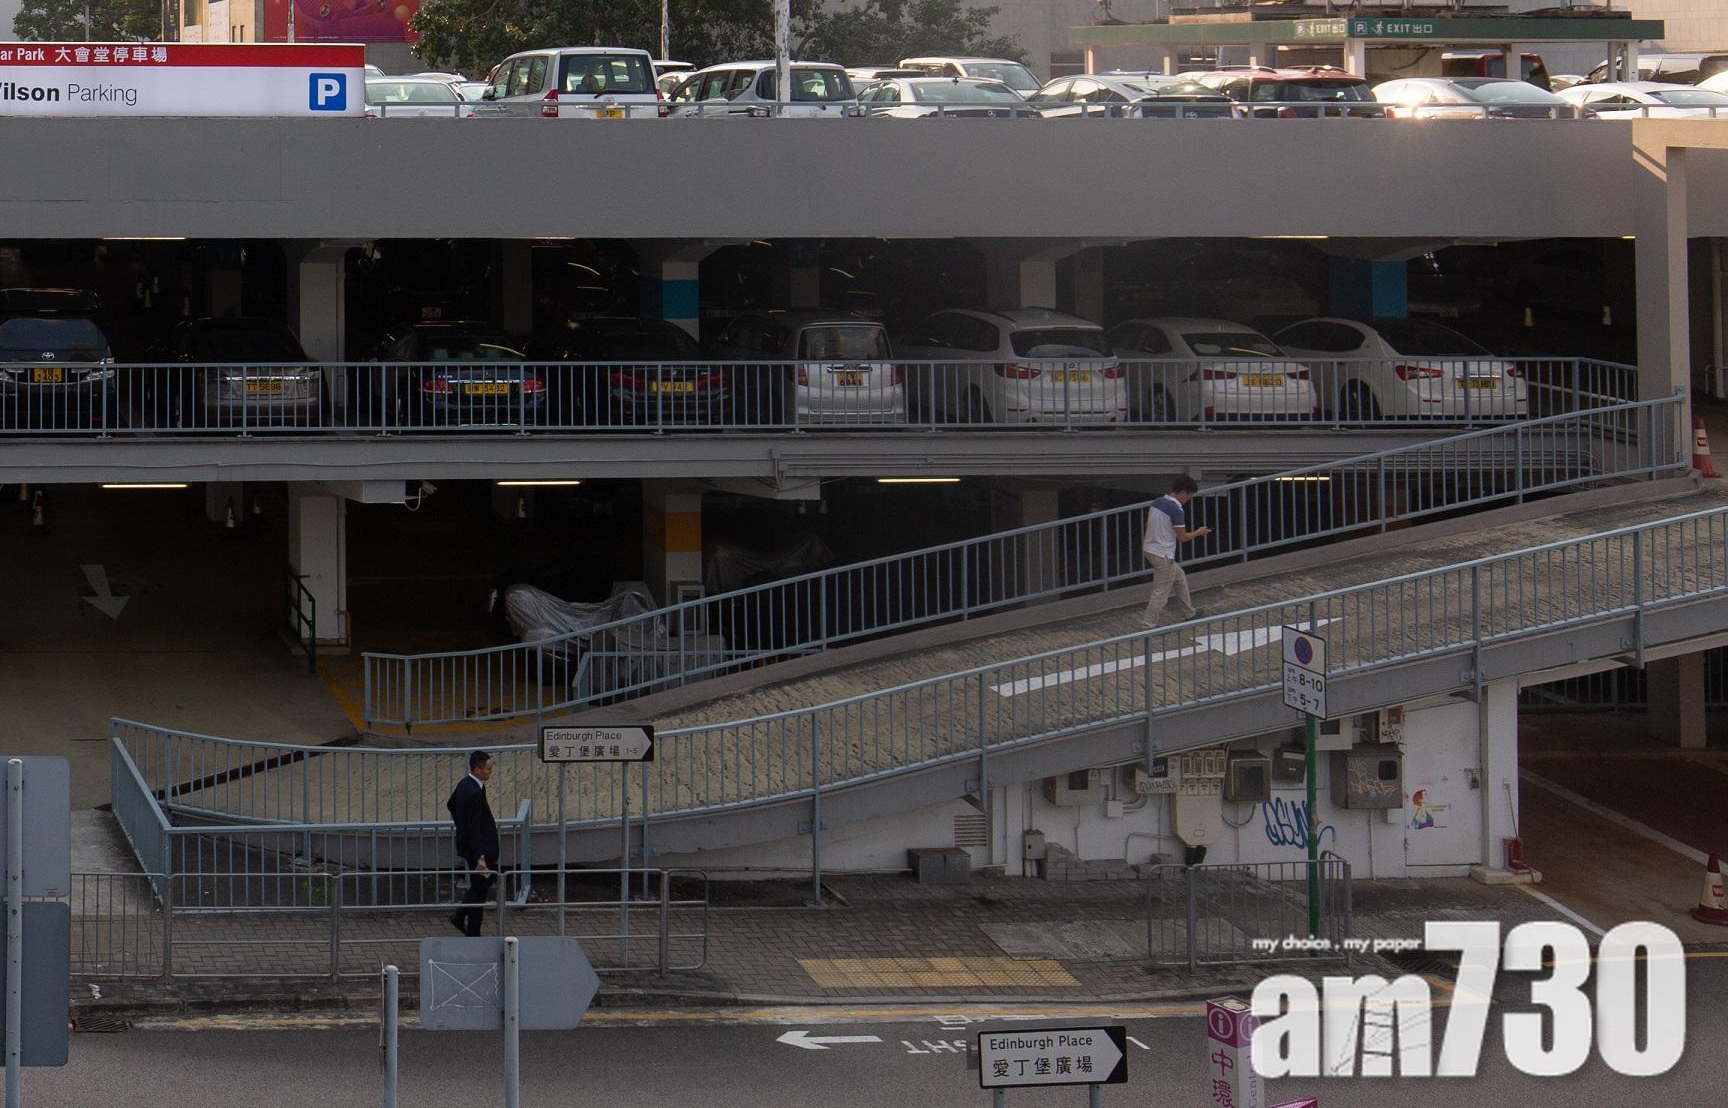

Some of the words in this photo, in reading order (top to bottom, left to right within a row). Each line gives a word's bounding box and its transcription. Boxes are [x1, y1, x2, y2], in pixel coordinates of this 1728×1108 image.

[1316, 24, 1331, 34] EXIT
[1387, 24, 1410, 34] EXIT
[17, 47, 46, 61] Park
[54, 46, 168, 64] 大會堂停車場
[68, 83, 138, 107] Parking
[317, 79, 340, 106] P
[1299, 673, 1323, 692] 8-10
[1300, 693, 1320, 711] 5-7
[546, 731, 592, 742] Edinburgh
[595, 731, 622, 741] Place
[549, 745, 620, 757] 愛丁堡廣場
[990, 1035, 1054, 1051] Edinburgh
[1059, 1035, 1093, 1047] Place
[993, 1055, 1093, 1078] 愛丁堡廣場
